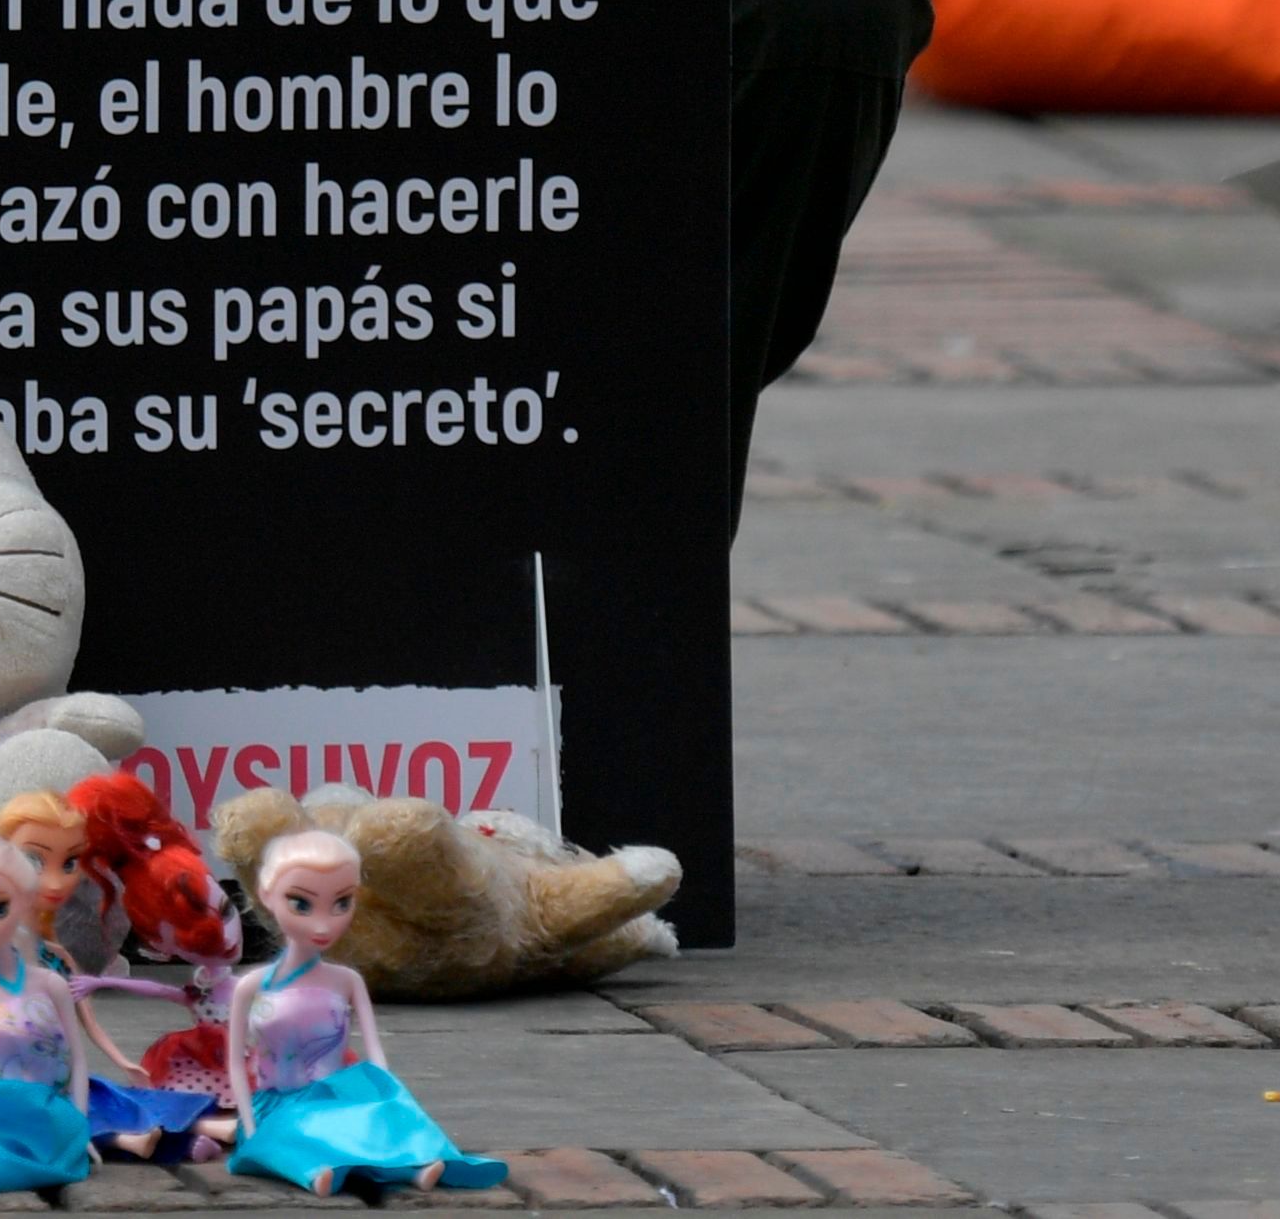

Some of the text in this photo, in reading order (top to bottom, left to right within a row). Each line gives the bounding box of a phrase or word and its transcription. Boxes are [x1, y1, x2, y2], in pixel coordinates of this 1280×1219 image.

[99, 60, 160, 135] el
[187, 56, 470, 133] hombre
[496, 53, 557, 127] lo
[147, 179, 277, 240] con
[305, 158, 580, 236] hacerle
[61, 286, 188, 348] sus
[214, 264, 434, 360] papás
[456, 262, 517, 340] si
[134, 394, 217, 452] su
